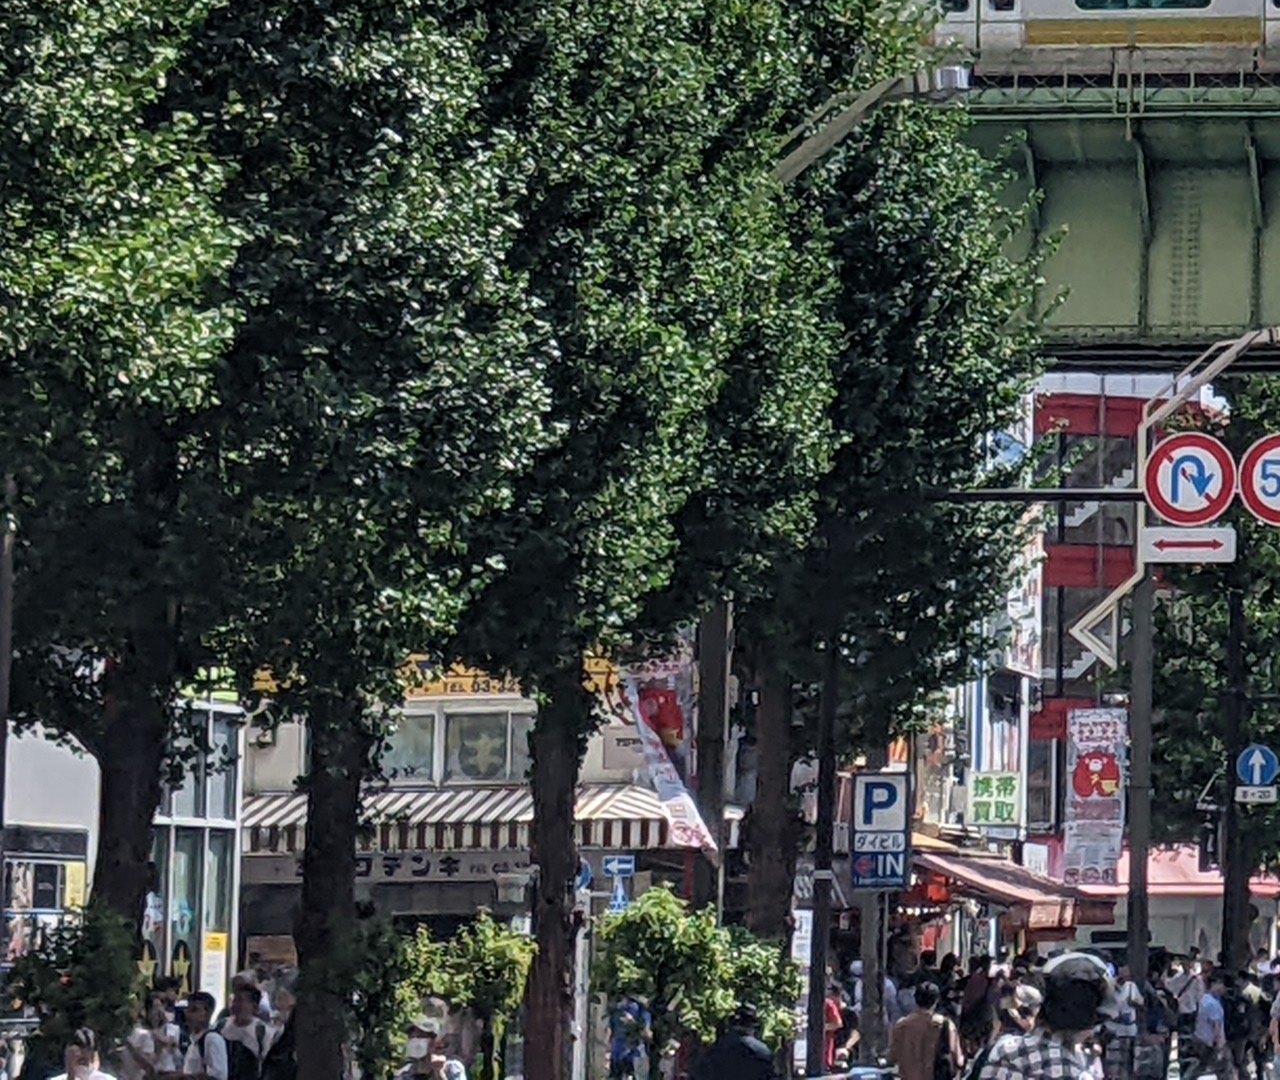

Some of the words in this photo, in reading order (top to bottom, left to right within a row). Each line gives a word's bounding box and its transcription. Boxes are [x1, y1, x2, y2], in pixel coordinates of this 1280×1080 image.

[973, 775, 1017, 798] 携帯
[863, 782, 898, 825] P
[877, 853, 904, 877] IN
